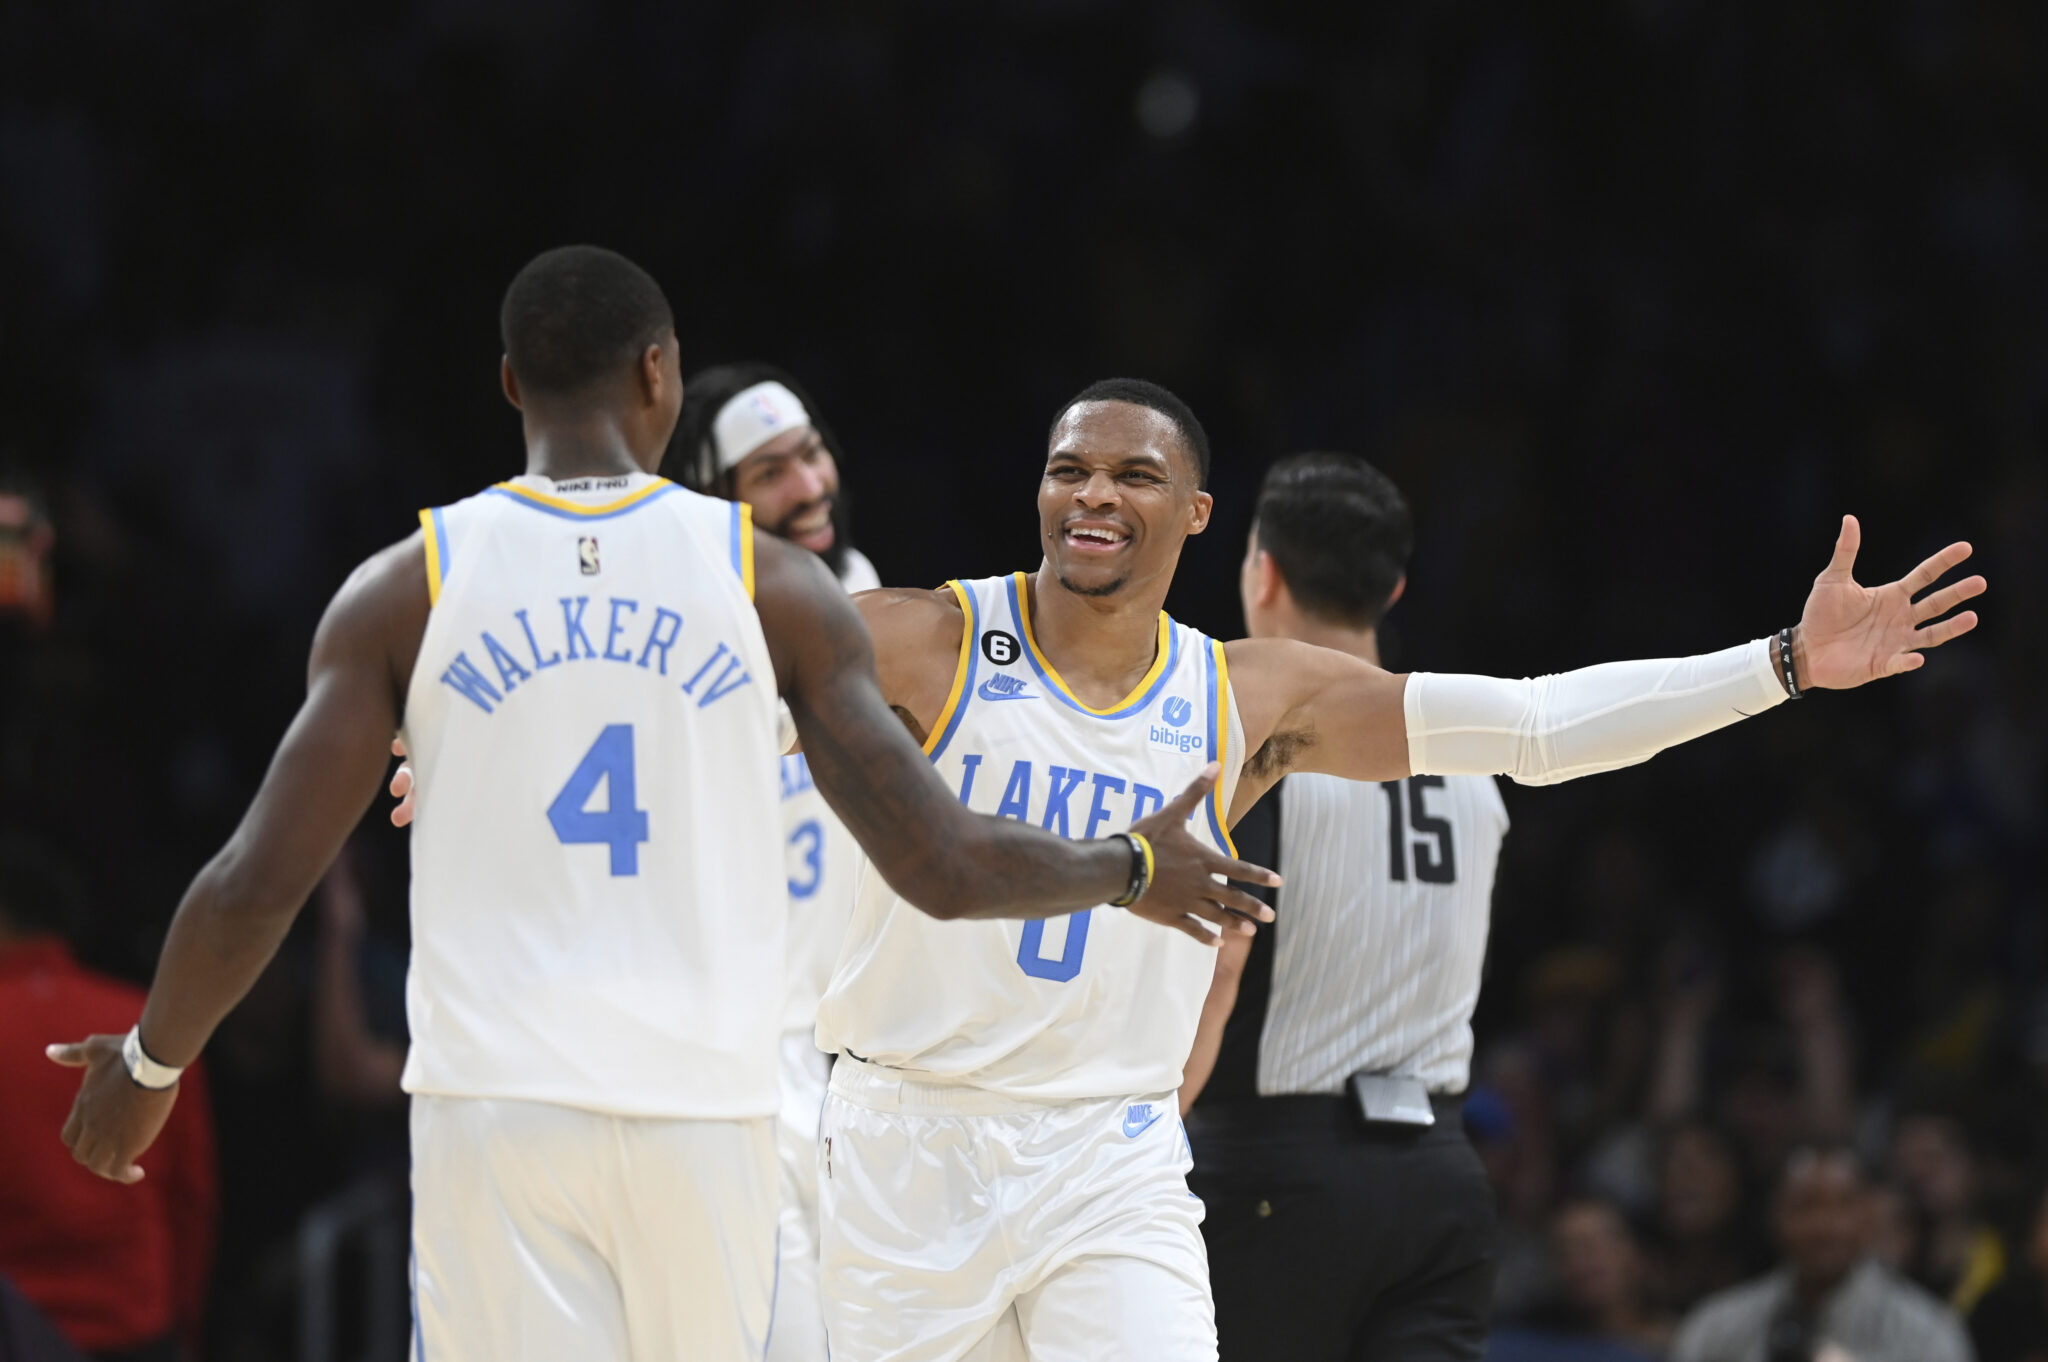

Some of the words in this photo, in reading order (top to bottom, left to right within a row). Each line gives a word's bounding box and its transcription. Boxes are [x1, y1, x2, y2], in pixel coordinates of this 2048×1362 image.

[440, 596, 683, 714] WALKER
[682, 642, 752, 708] IV
[990, 635, 1011, 661] 6
[987, 672, 1028, 696] NIKE
[1150, 724, 1203, 753] bibigo
[547, 724, 649, 876] 4
[1379, 774, 1456, 884] 15
[787, 816, 825, 899] 3
[1127, 1103, 1153, 1124] NIKE
